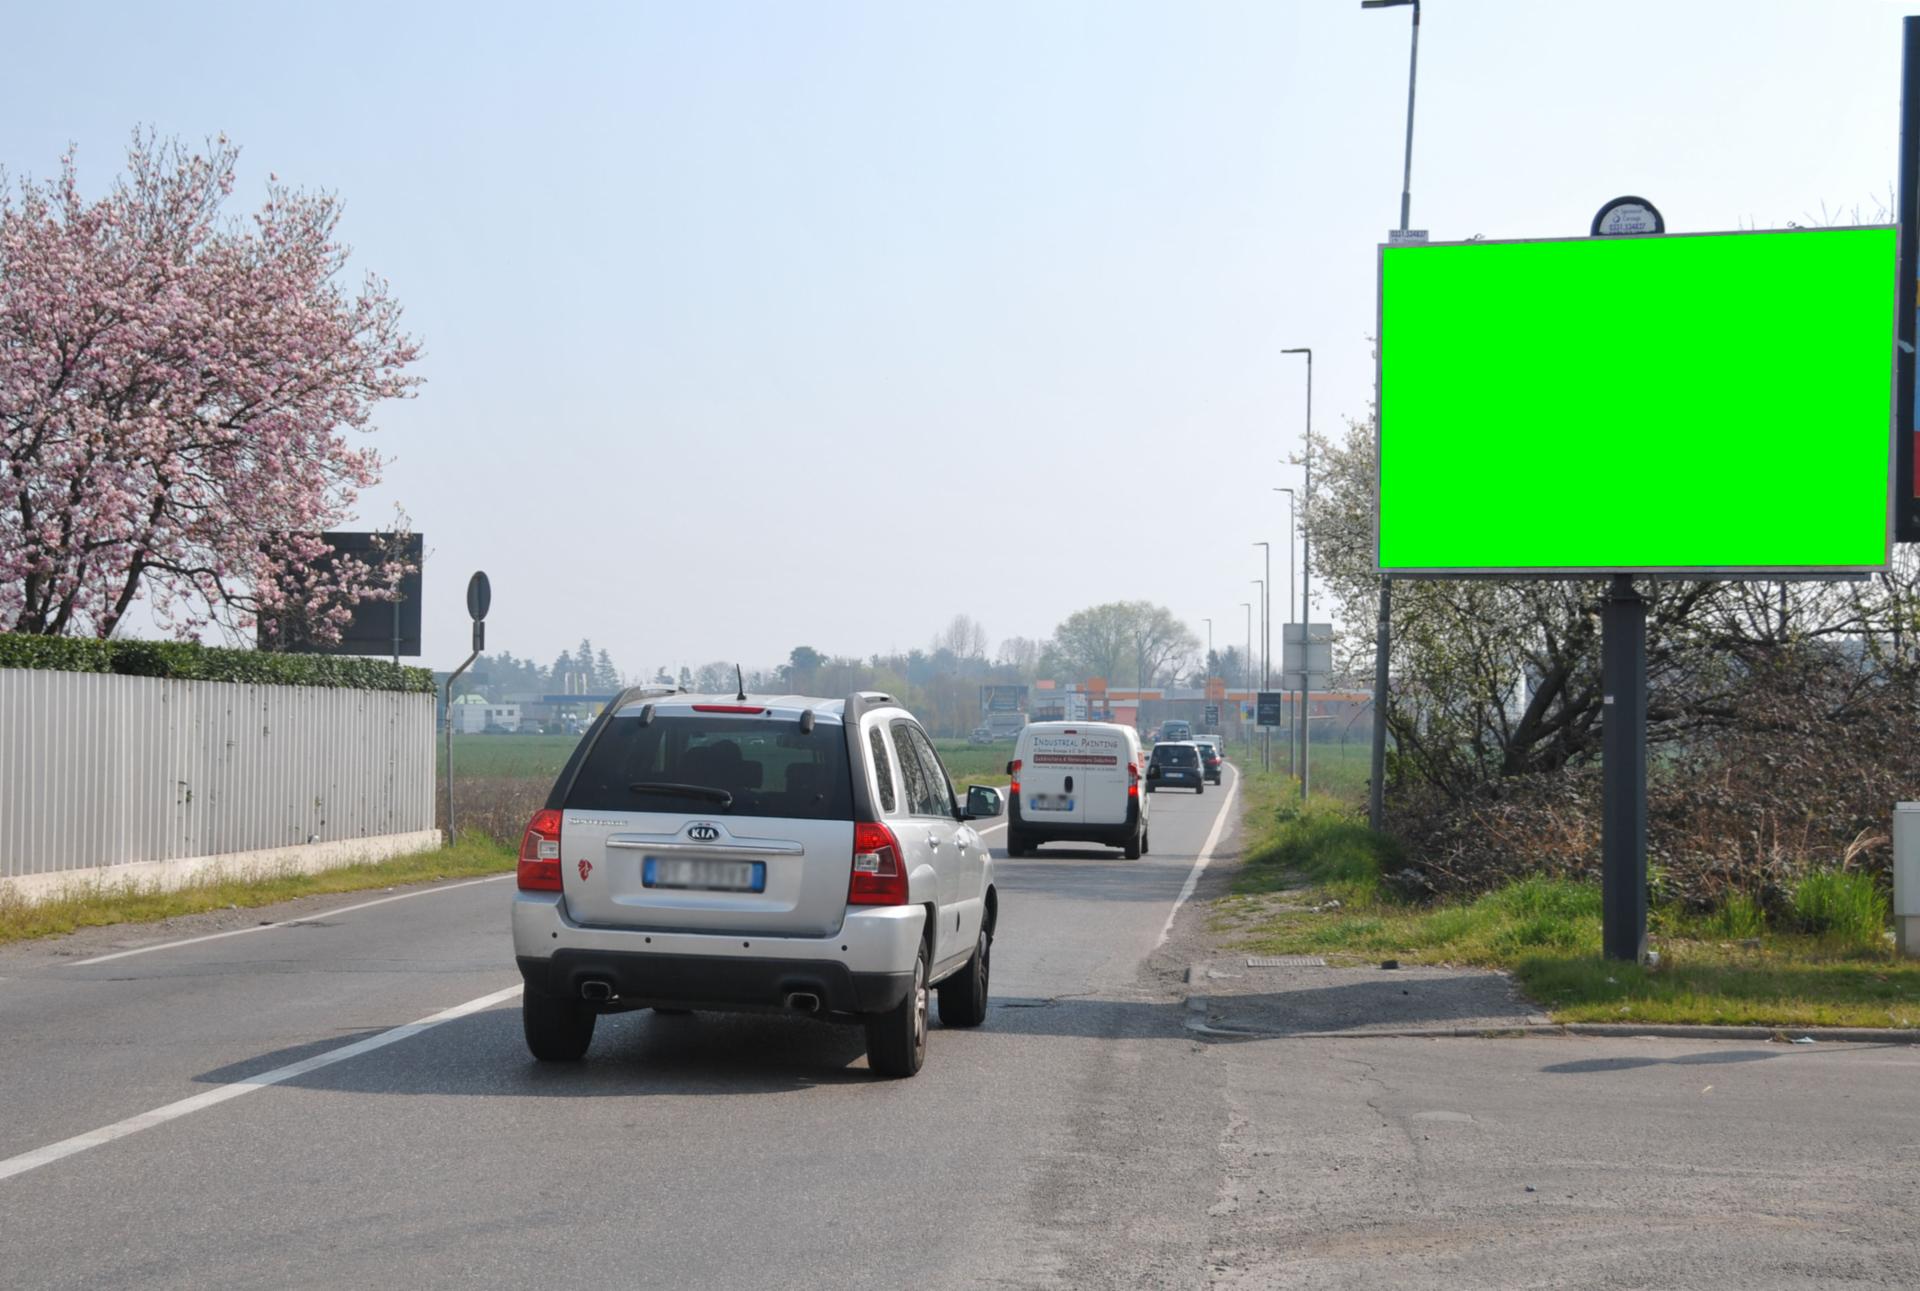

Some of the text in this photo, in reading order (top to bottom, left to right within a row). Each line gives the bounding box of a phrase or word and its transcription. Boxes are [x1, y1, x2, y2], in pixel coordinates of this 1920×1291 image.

[1033, 737, 1118, 748] INDUSTRIAL PAINTING
[691, 827, 715, 839] KIA
